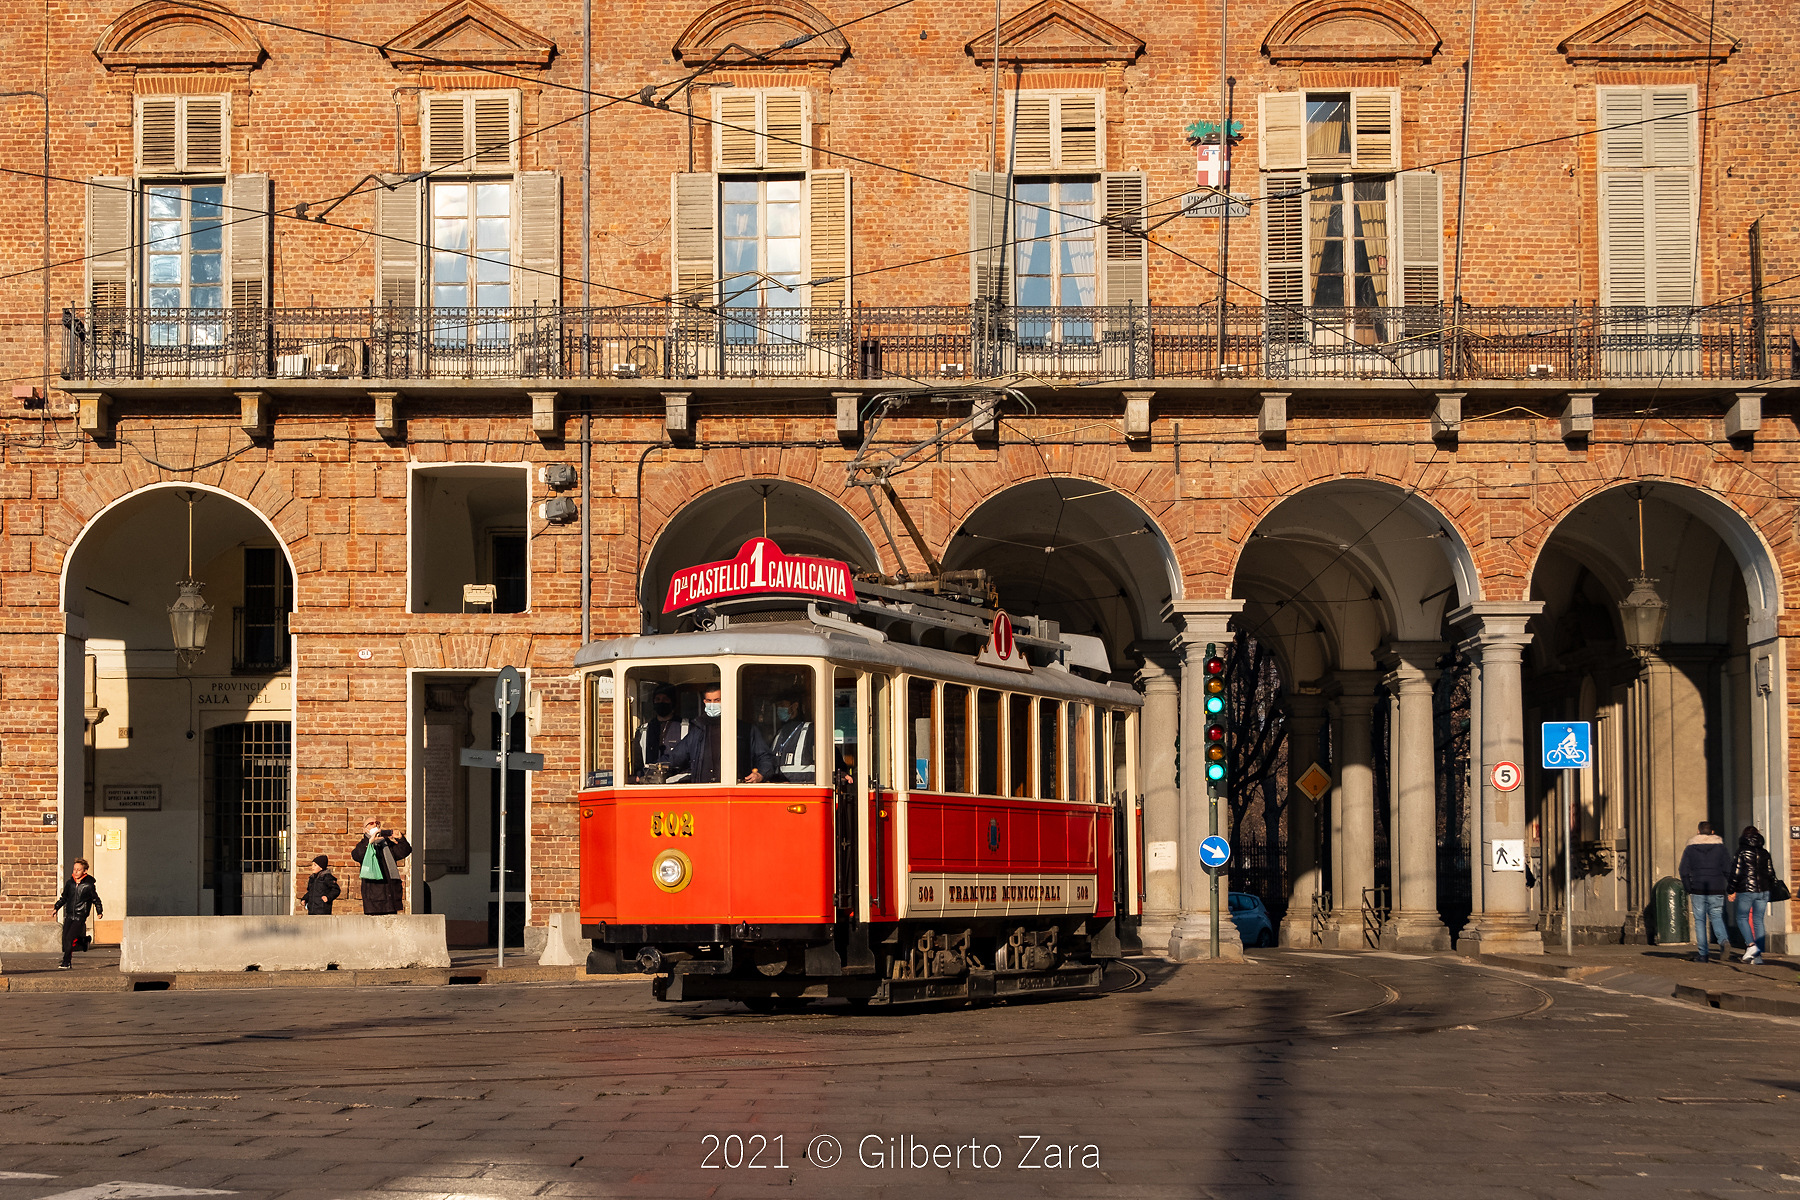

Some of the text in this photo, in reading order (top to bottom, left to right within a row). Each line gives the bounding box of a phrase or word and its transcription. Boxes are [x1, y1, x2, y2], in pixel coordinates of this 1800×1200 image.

[689, 562, 748, 600] CASTELLO
[750, 542, 766, 587] 1
[768, 561, 847, 597] CAVALCAVIA
[999, 615, 1007, 657] 1
[211, 682, 291, 691] PROVINCIA DI
[198, 694, 271, 704] SALA DEL
[1501, 769, 1511, 783] 5
[650, 811, 694, 838] 502
[918, 885, 1089, 902] 502 TRAMVIE MUNICIPALI 502
